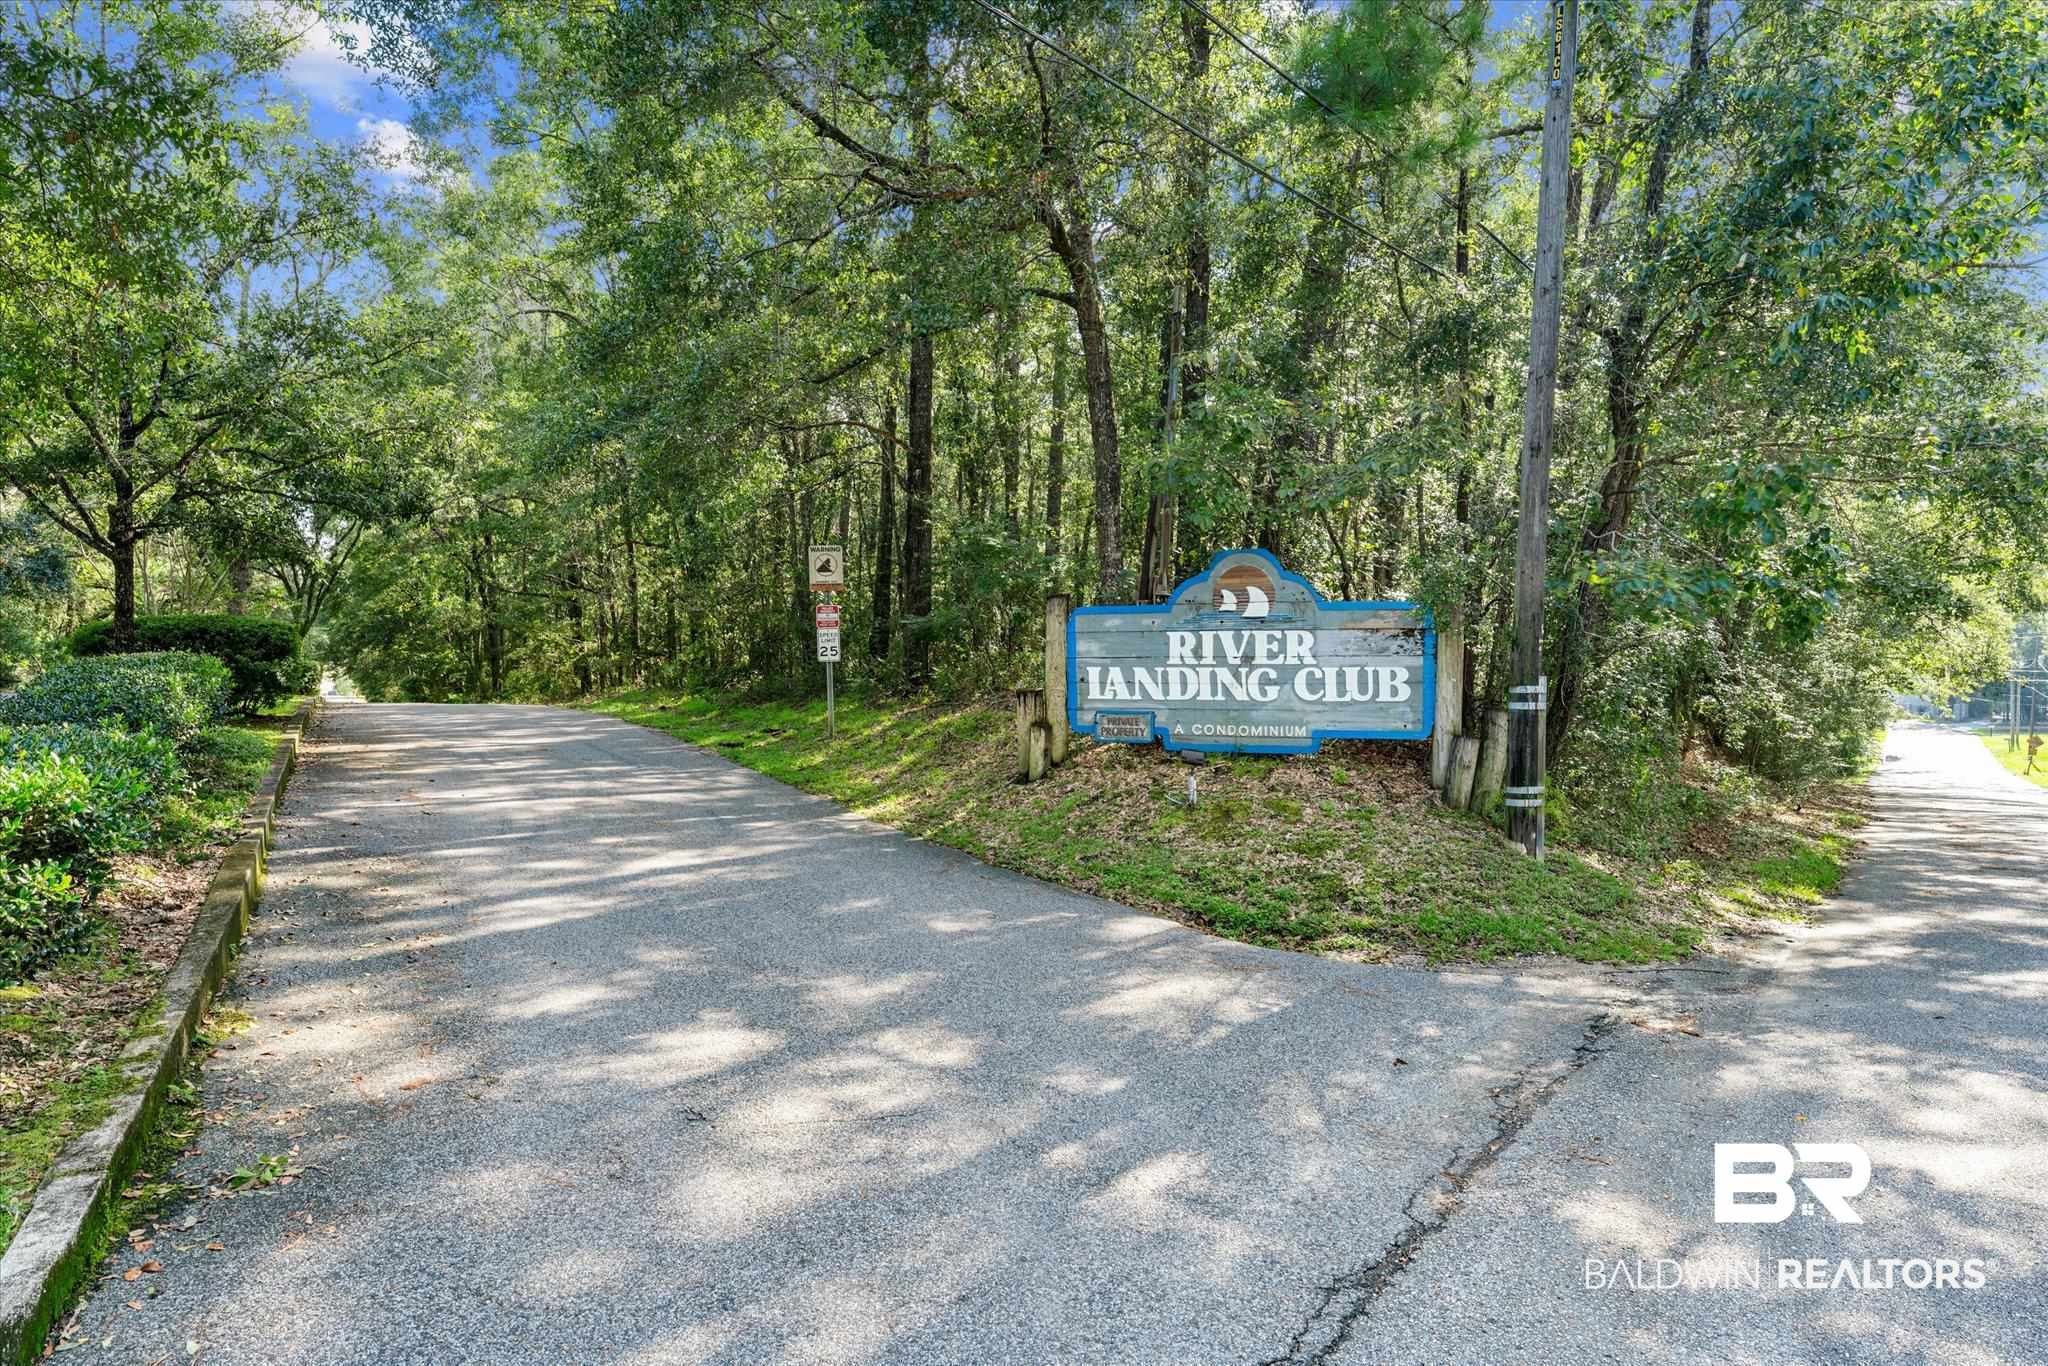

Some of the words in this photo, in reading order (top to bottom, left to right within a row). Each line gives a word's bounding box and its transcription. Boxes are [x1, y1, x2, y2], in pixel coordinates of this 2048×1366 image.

[820, 646, 840, 656] 25
[1166, 630, 1317, 665] RIVER
[1086, 665, 1281, 703] LANDING
[1293, 666, 1412, 703] CLUB
[1105, 717, 1142, 727] PRIVATE
[1101, 727, 1147, 738] PROPERTY
[1174, 723, 1184, 734] A
[1191, 724, 1307, 738] CONDOMINIUM
